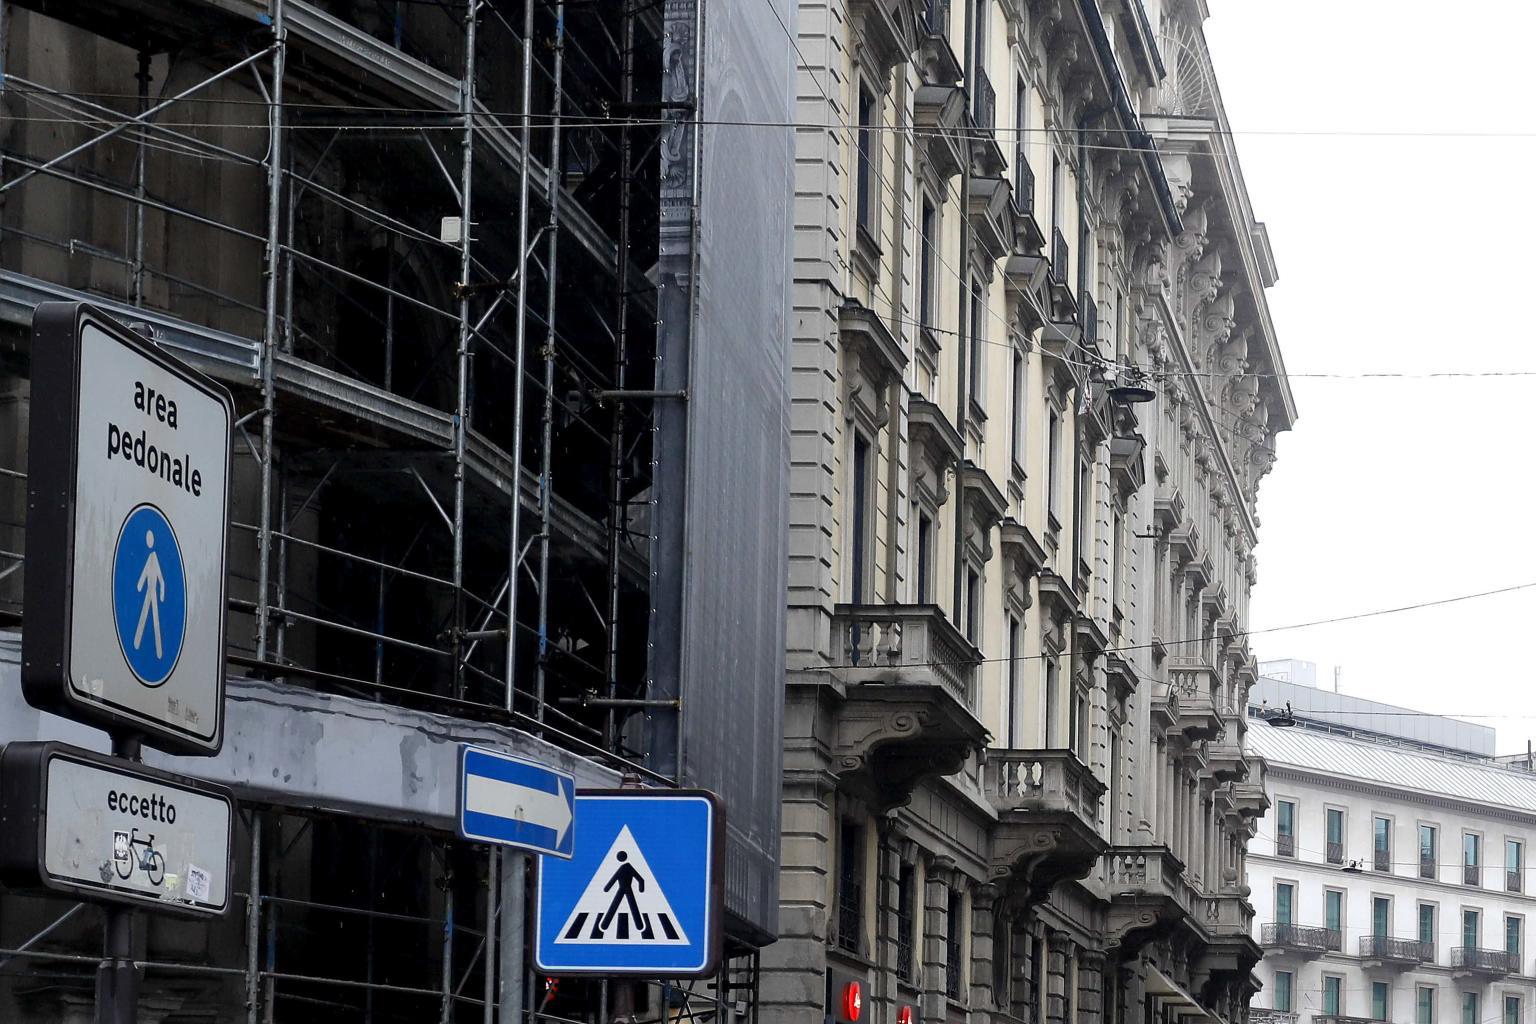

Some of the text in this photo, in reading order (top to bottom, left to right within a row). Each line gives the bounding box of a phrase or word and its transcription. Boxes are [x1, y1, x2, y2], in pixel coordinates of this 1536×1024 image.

[133, 381, 178, 430] area
[107, 422, 202, 497] pedonale
[107, 790, 177, 825] eccetto
